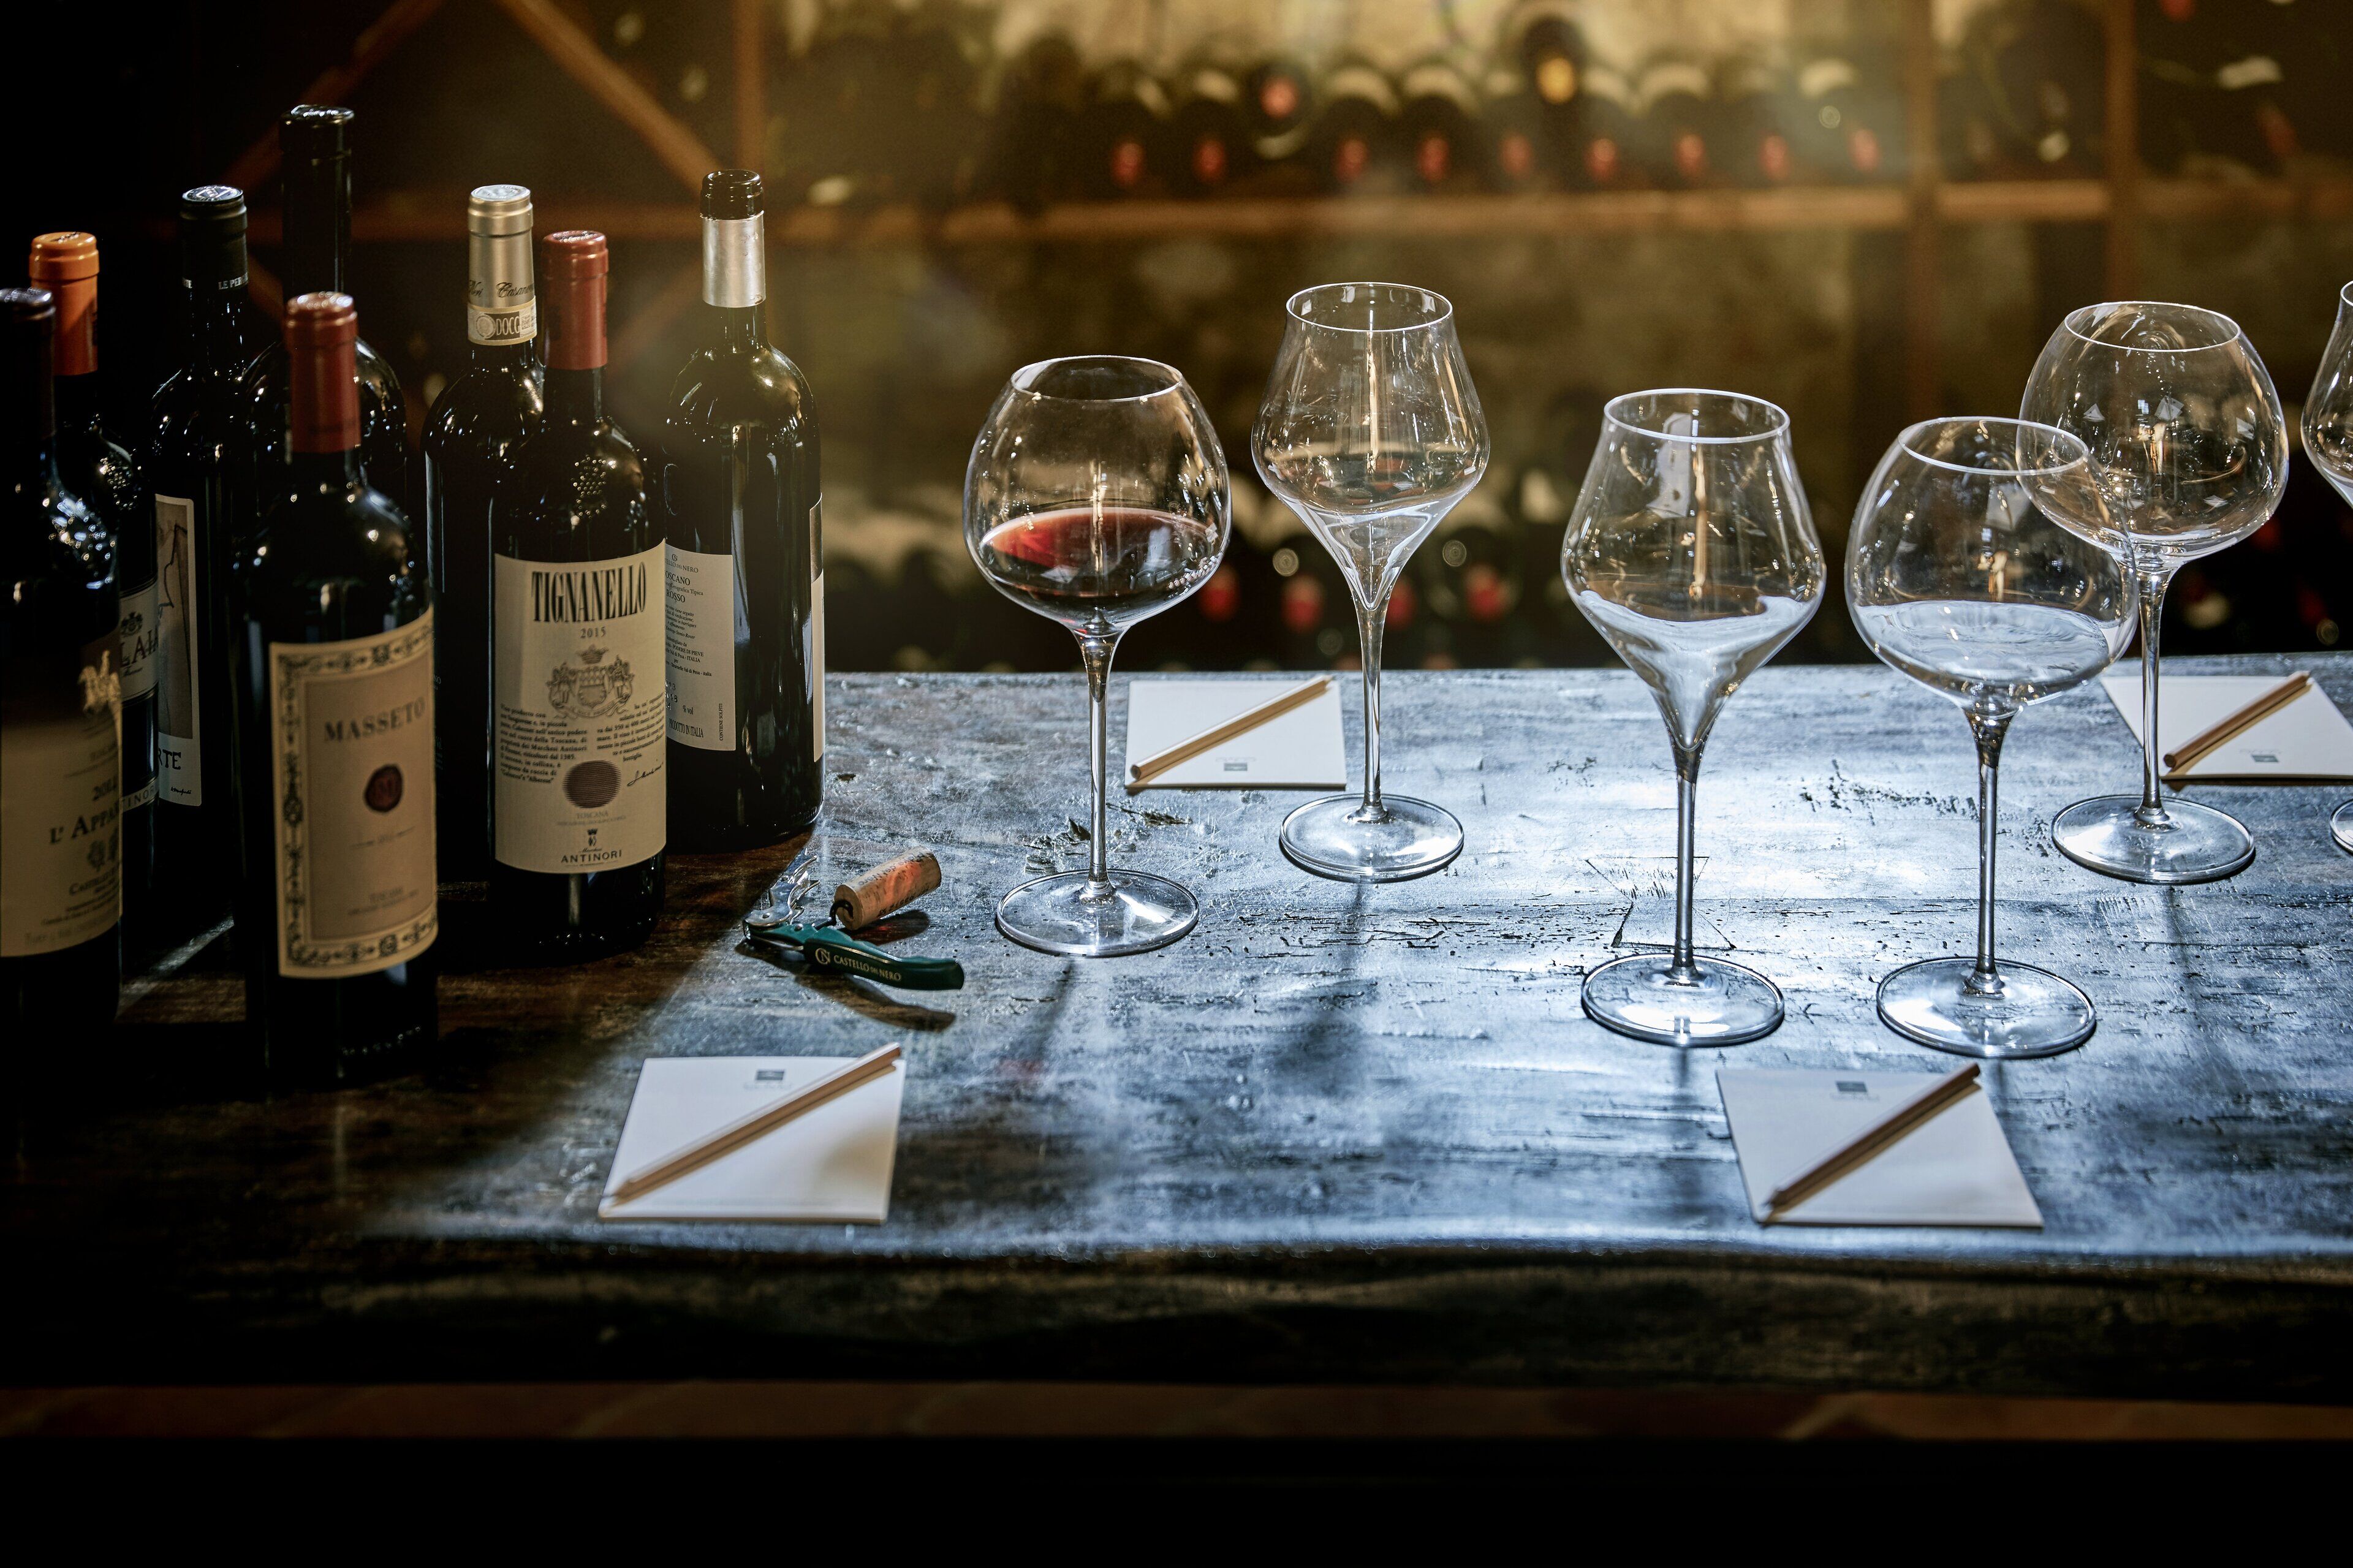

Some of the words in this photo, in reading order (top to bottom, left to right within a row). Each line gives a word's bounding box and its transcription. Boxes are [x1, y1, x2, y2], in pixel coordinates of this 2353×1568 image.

[496, 316, 520, 336] DOCG
[683, 565, 699, 574] NERO
[531, 561, 646, 624] TIGNANELLO
[666, 589, 686, 603] ROSSO
[580, 627, 607, 638] 2015
[325, 696, 426, 743] MASSETO
[669, 718, 686, 733] PRODOTTO
[691, 726, 704, 738] ITALIA
[561, 849, 623, 863] ANTINORI
[833, 955, 870, 972] CASTELLO
[879, 969, 902, 981] NERO
